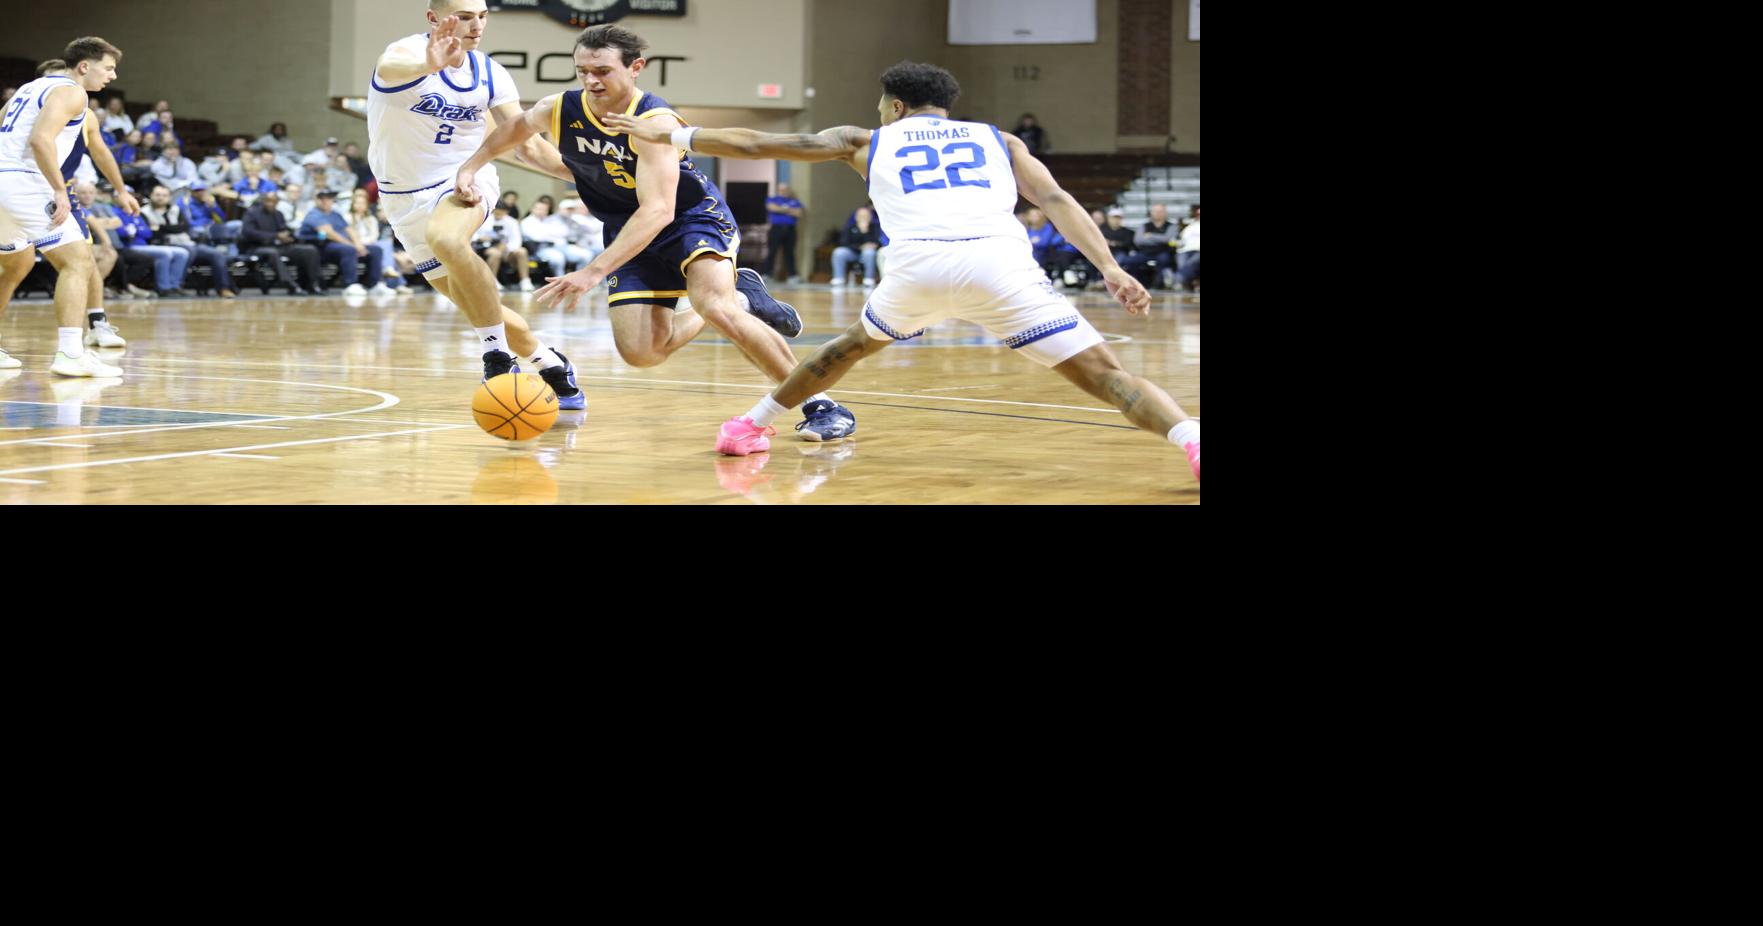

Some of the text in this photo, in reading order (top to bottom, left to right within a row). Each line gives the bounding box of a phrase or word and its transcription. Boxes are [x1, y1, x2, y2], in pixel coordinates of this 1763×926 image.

[1013, 65, 1042, 82] 112
[0, 97, 30, 132] 21
[434, 123, 455, 145] 2
[904, 127, 970, 142] THOMAS
[603, 160, 637, 189] 5
[895, 142, 991, 194] 22
